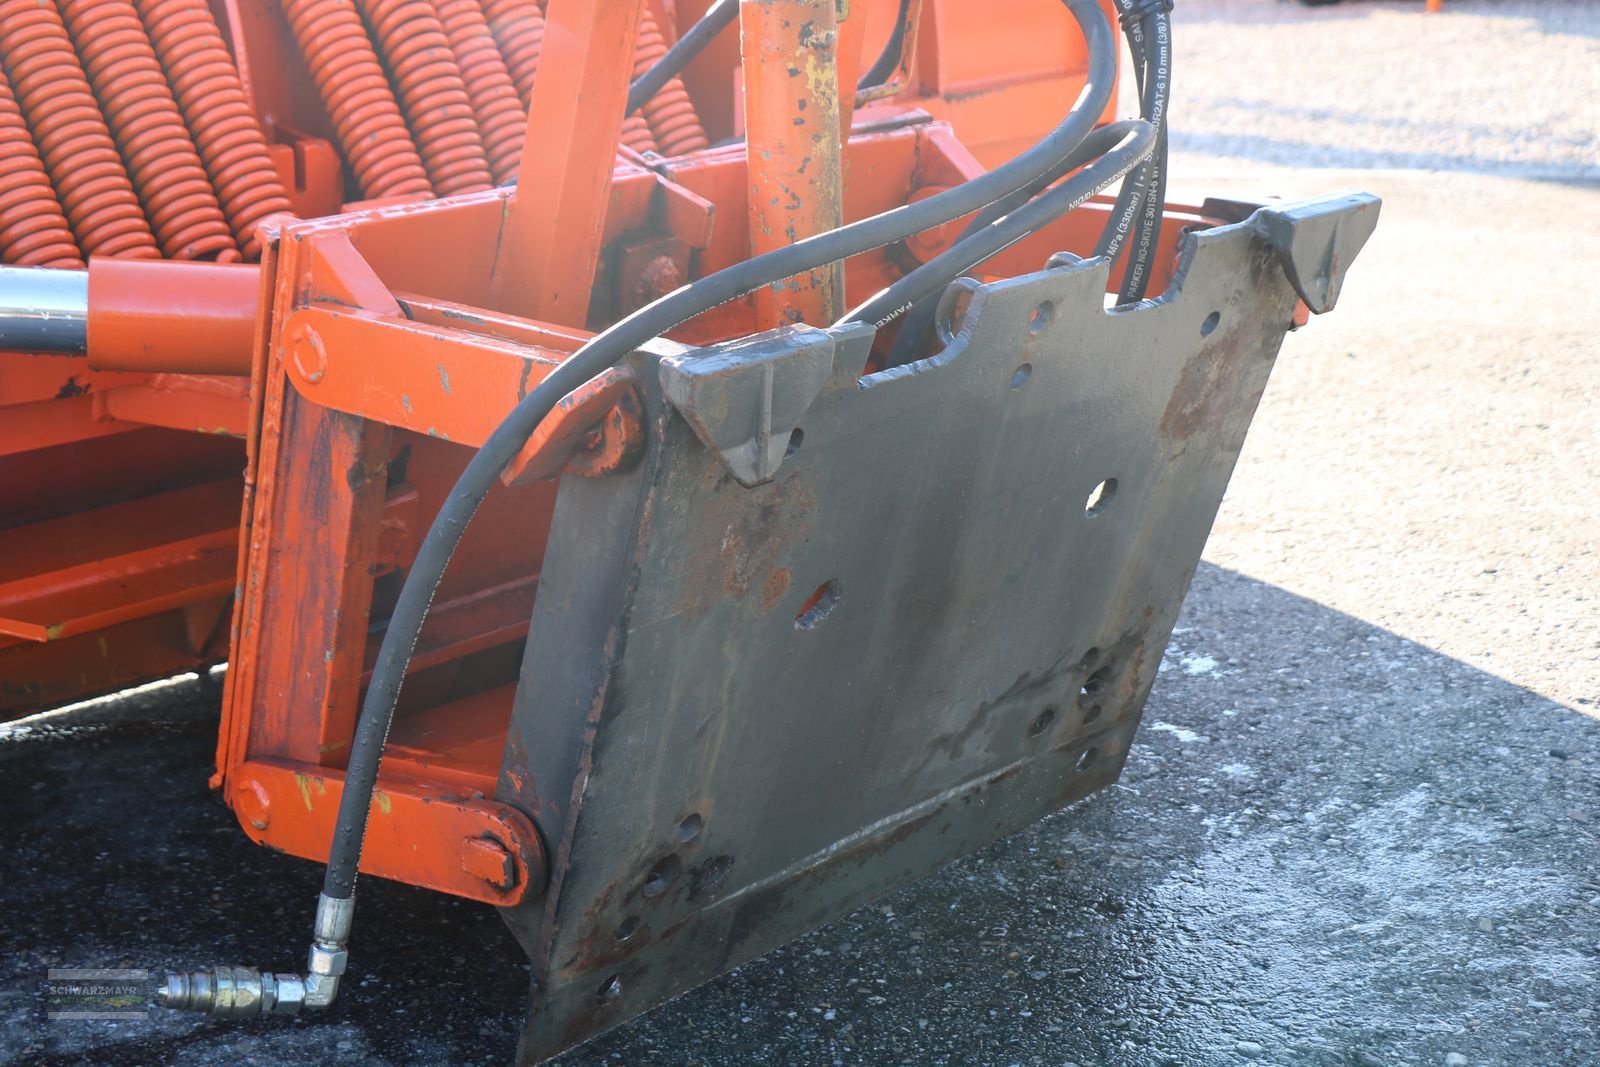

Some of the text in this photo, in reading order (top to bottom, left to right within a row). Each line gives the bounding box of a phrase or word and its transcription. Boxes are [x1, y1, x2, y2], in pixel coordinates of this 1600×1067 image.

[1157, 21, 1168, 44] (3/8)
[1159, 46, 1168, 67] mm
[1158, 68, 1167, 80] 10
[1107, 232, 1124, 257] MPa
[1117, 191, 1142, 234] (330bar)
[1127, 262, 1145, 298] PARKER
[1136, 221, 1153, 263] NO-SKIVE
[1145, 180, 1159, 219] 301SN-6
